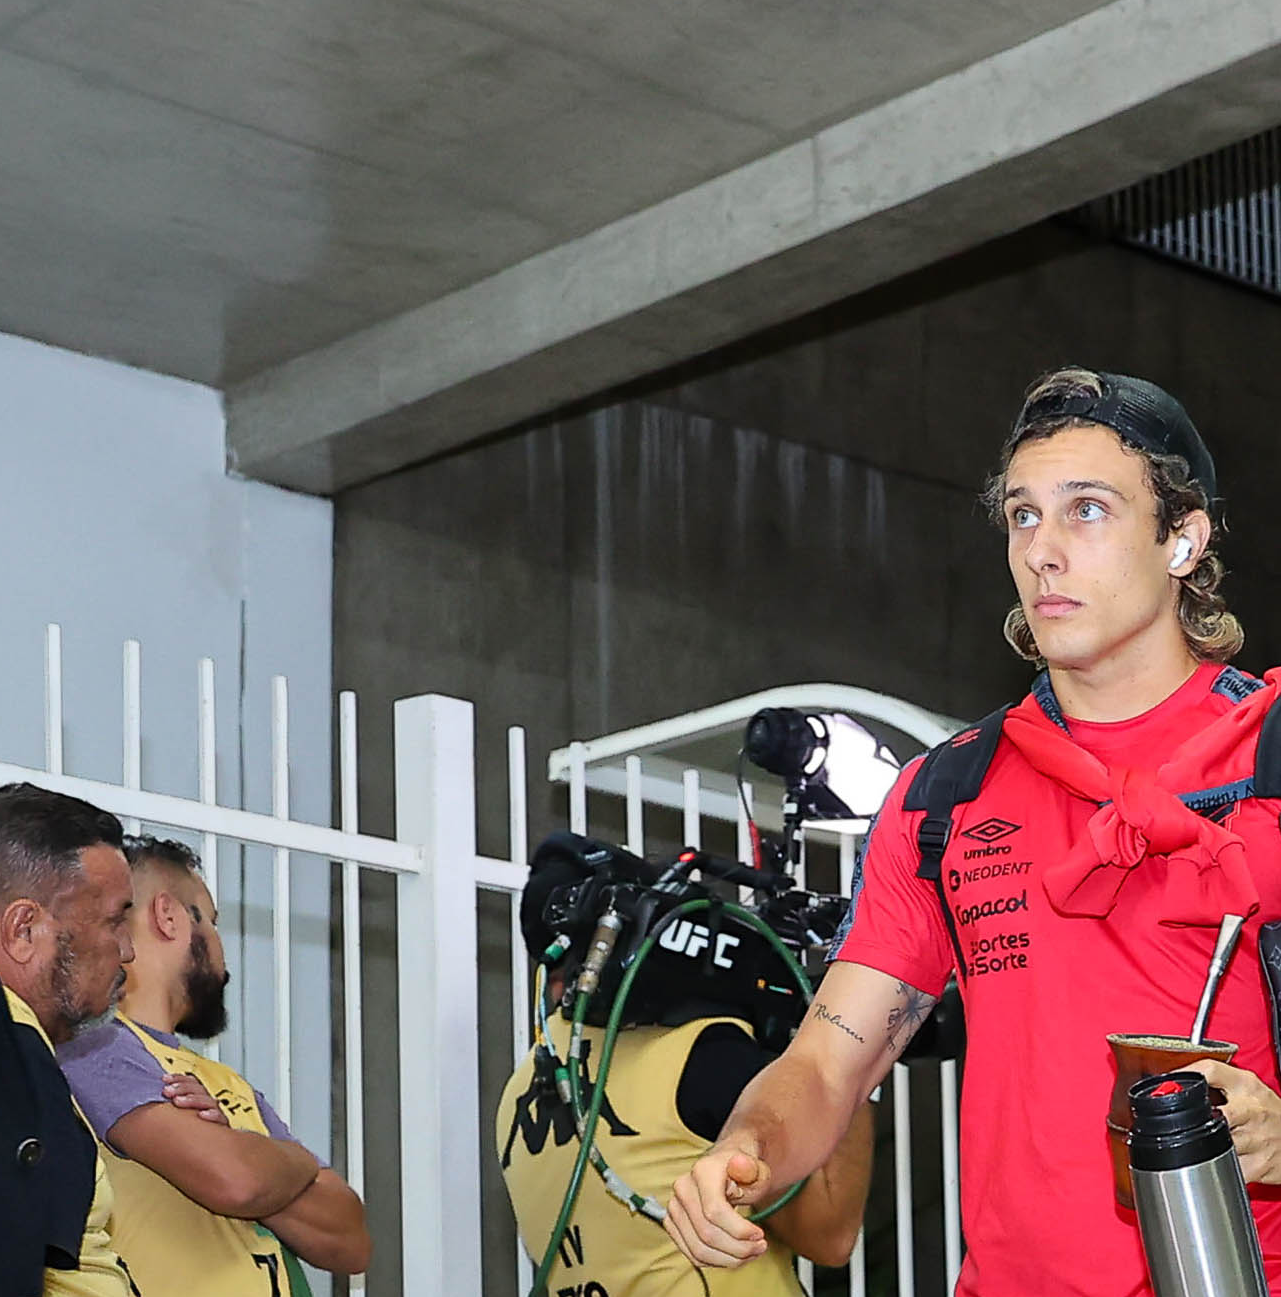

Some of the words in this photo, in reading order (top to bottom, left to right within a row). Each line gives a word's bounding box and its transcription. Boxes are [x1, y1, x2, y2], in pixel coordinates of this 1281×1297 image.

[963, 845, 1012, 860] umbro
[963, 862, 1034, 884] NEODENT
[955, 889, 1028, 928] Copacol
[659, 918, 740, 969] UFC
[970, 932, 1031, 956] ortes
